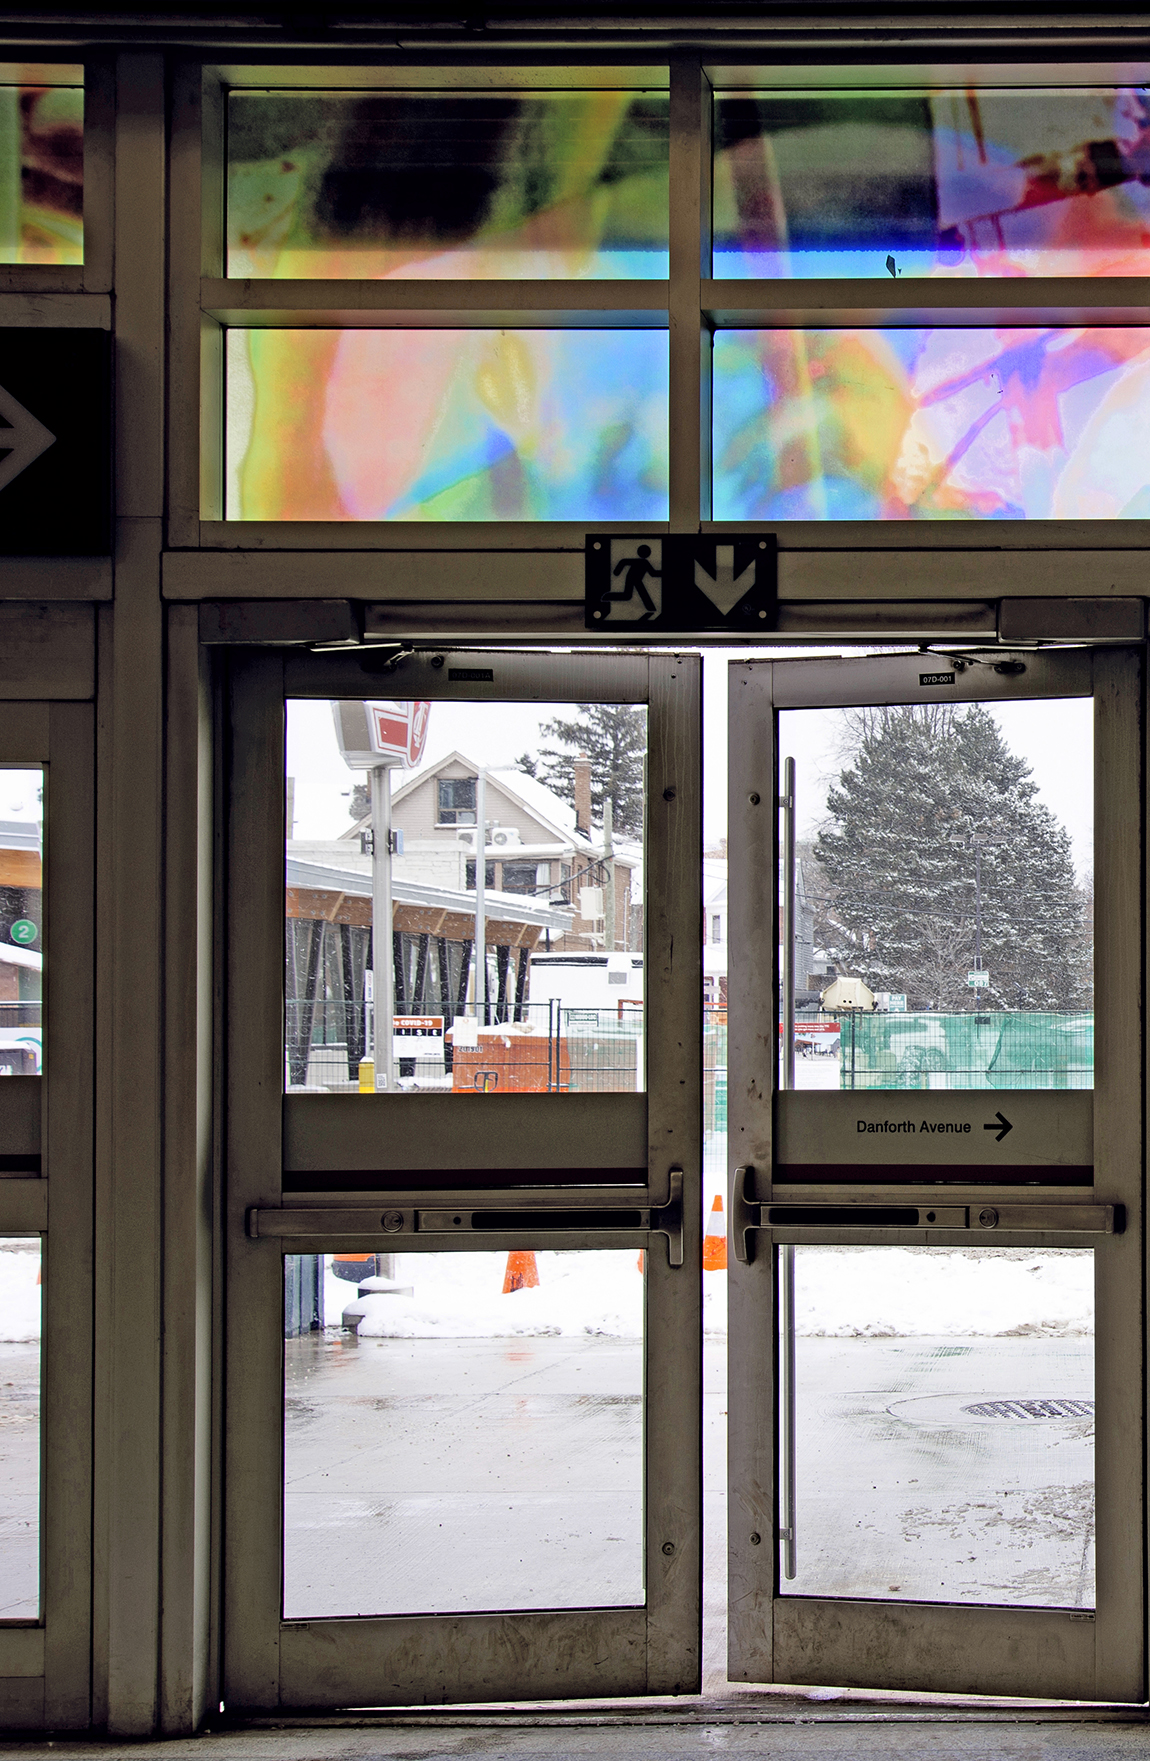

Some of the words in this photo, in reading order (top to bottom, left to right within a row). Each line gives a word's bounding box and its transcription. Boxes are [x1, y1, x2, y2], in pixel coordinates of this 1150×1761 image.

[923, 675, 952, 683] 07D-001
[18, 925, 29, 938] 2
[857, 1120, 915, 1133] Danforth
[919, 1120, 971, 1133] Avenue
